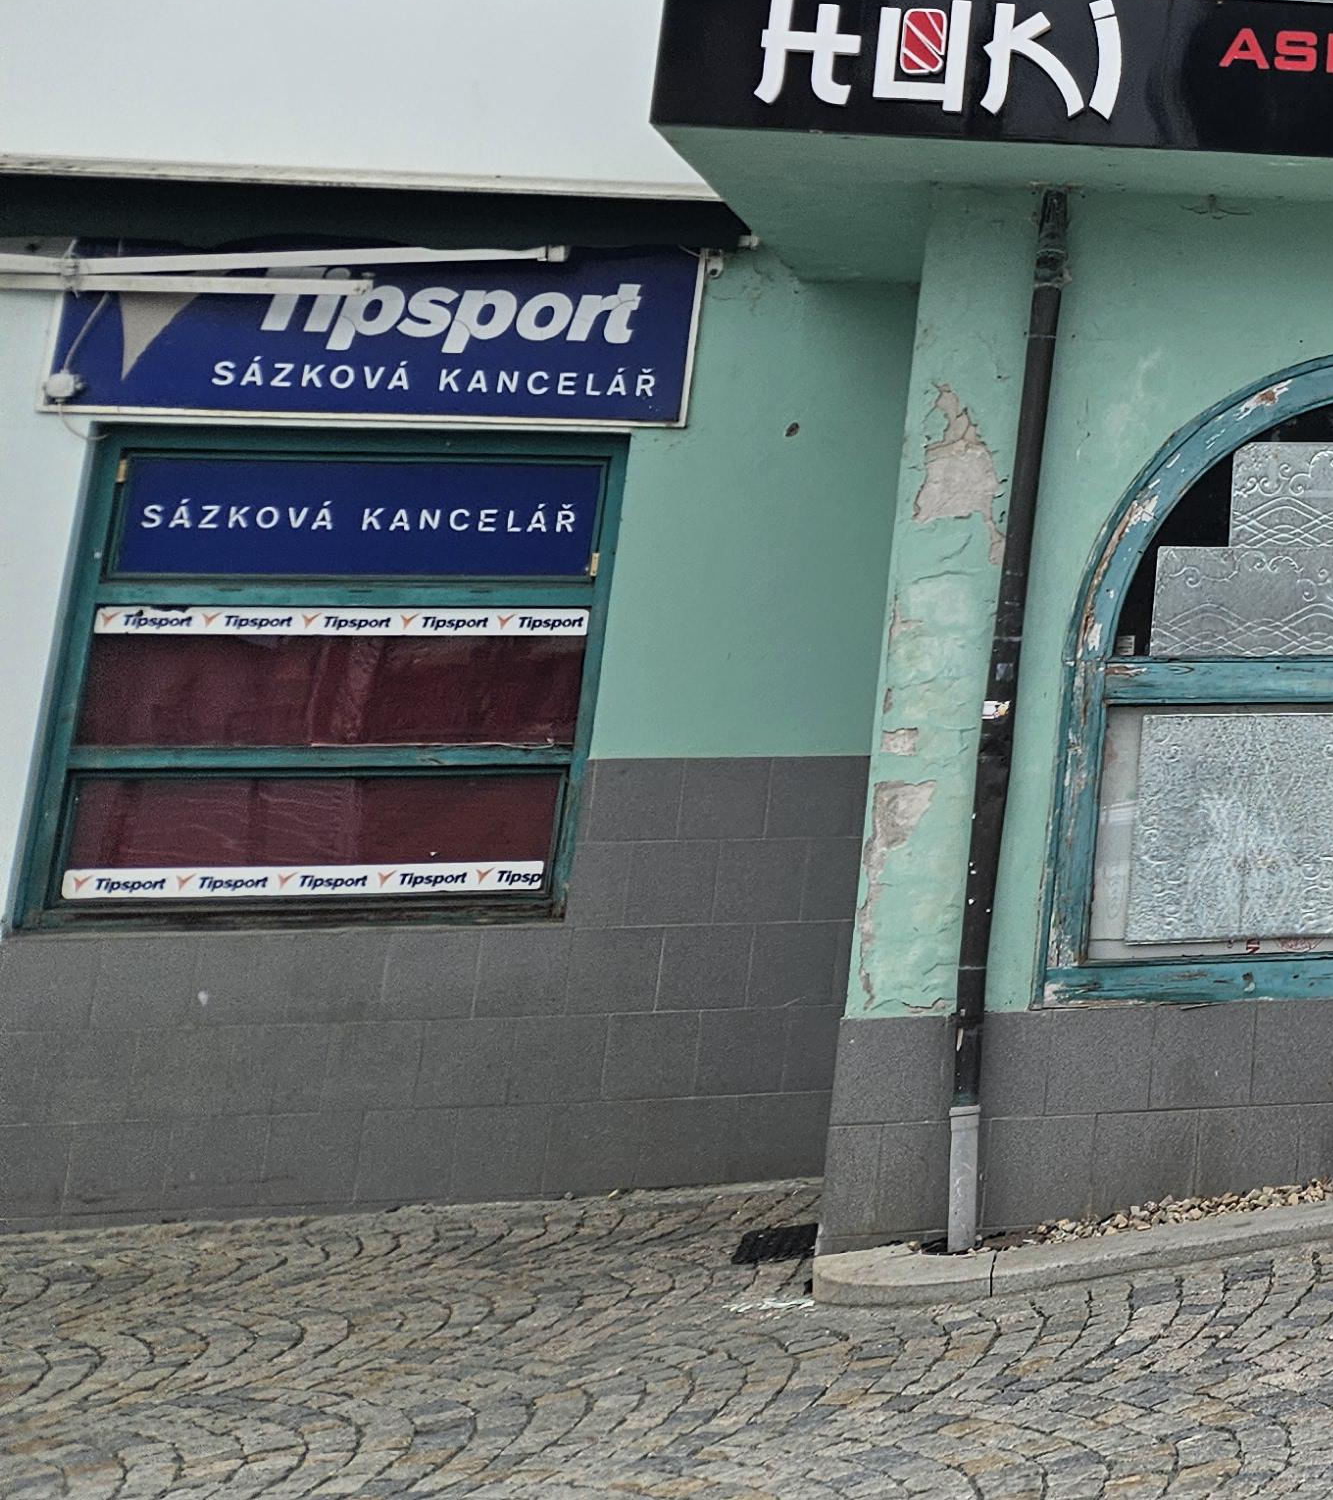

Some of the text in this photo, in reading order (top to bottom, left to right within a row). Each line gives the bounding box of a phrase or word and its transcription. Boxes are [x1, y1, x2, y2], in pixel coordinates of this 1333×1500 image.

[259, 267, 642, 354] Tipsport
[211, 355, 657, 398] SÁZKOVÁ KANCELÁŘ
[141, 498, 577, 533] SÁZKOVÁ KANCELÁŘ
[122, 612, 192, 630] Tipsport
[223, 613, 293, 631] Tipsport
[322, 614, 391, 631] Tipsport
[420, 614, 489, 631] Tipsport
[516, 614, 584, 631] Tipsport
[94, 875, 167, 892] Tipsport
[198, 875, 269, 892] Tipsport
[298, 873, 368, 891] Tipsport
[398, 870, 468, 889] Tipsport
